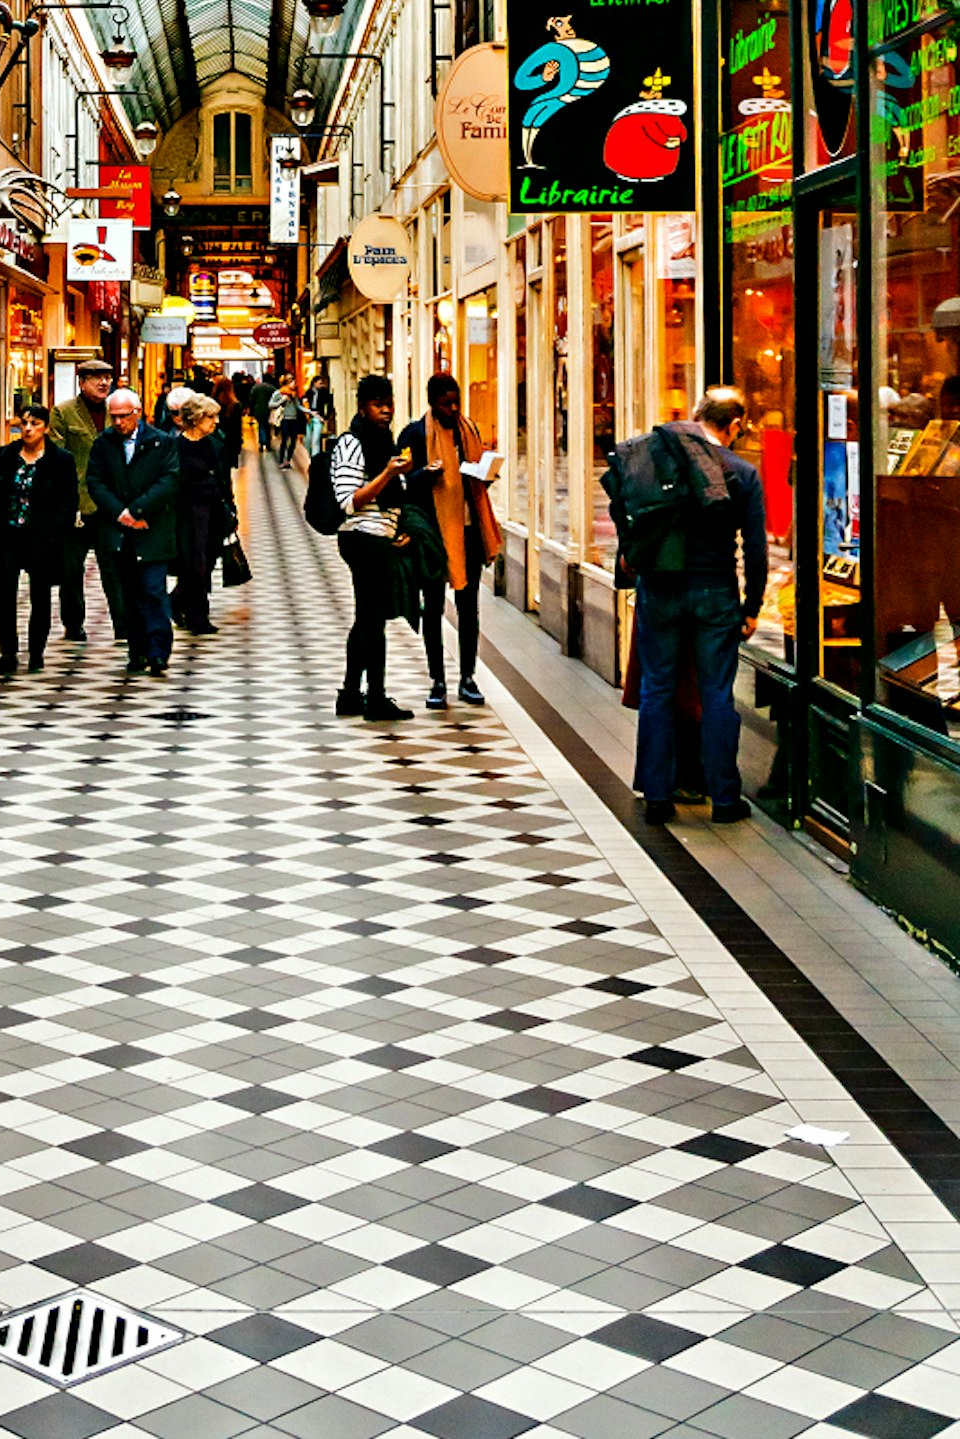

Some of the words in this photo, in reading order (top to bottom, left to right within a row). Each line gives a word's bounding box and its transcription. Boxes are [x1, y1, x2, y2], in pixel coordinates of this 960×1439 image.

[729, 12, 777, 74] Librairie
[519, 176, 634, 207] Librairie
[364, 245, 396, 255] Pain
